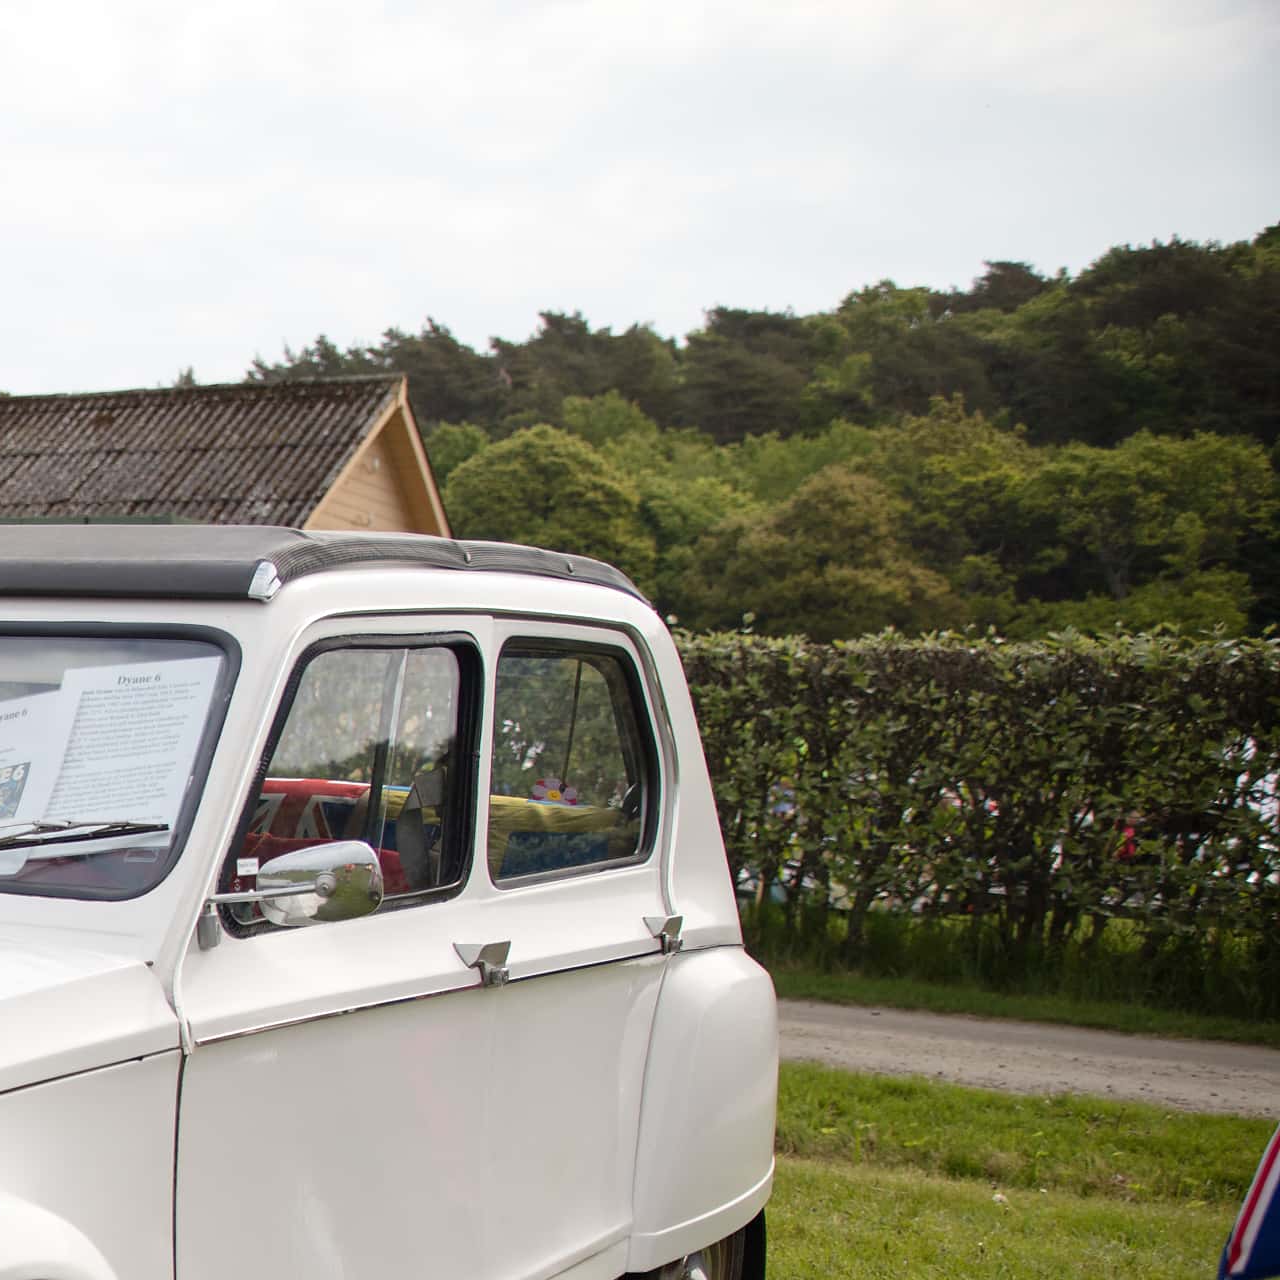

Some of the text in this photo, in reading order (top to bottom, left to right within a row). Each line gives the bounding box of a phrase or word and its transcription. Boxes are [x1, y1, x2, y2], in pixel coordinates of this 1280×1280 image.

[117, 672, 161, 687] Dyane 6
[11, 765, 25, 781] 6
